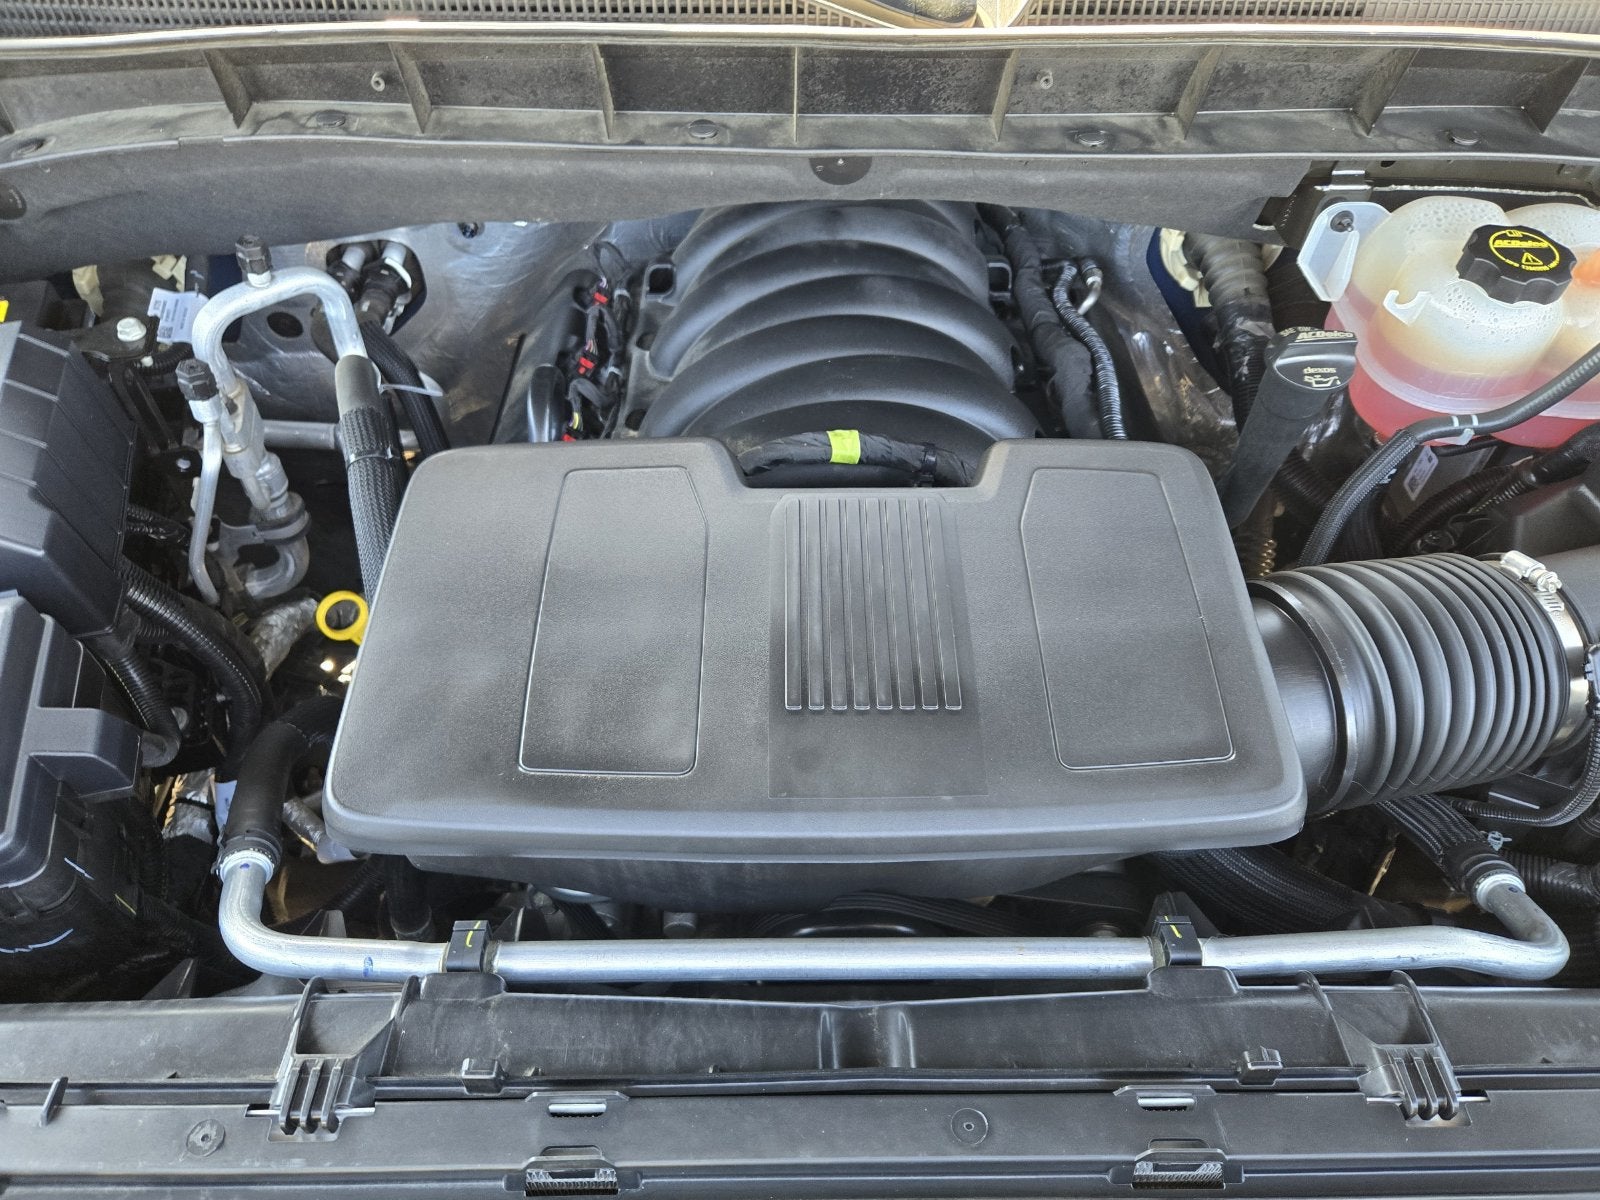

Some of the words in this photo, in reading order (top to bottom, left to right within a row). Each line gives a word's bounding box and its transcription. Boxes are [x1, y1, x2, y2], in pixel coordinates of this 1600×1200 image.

[1493, 239, 1549, 248] ACDelco
[1297, 331, 1353, 339] ACDelco
[1303, 366, 1337, 374] dexos
